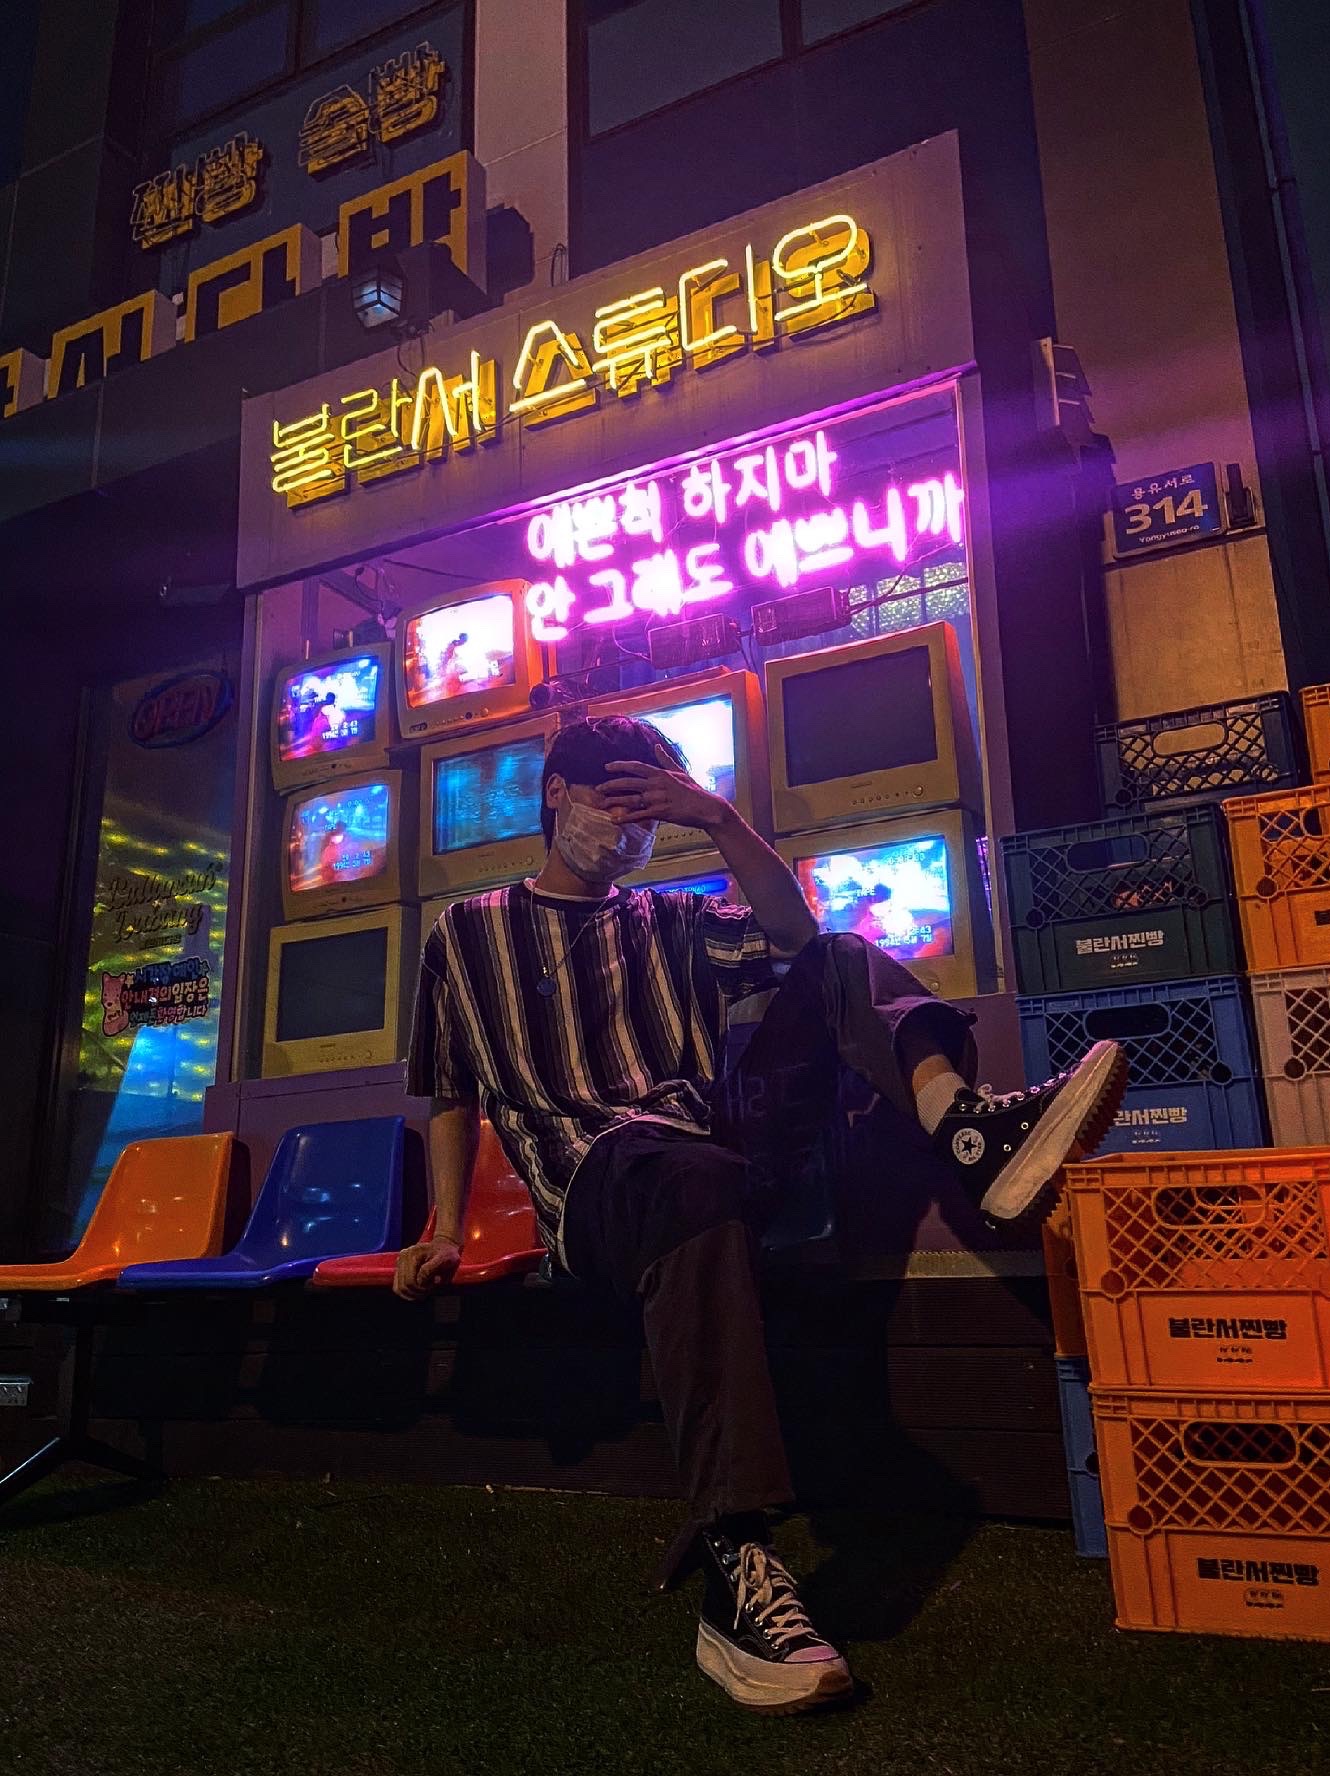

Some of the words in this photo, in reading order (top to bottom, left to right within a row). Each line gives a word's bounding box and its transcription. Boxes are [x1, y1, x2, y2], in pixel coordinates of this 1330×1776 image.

[270, 349, 498, 508] 불란서
[508, 213, 876, 431] 스튜디오
[526, 479, 663, 569] 예쁜척
[681, 430, 839, 524] 하지마
[1131, 474, 1195, 500] 용유서로
[1124, 489, 1209, 535] 314
[524, 573, 577, 642] 안
[582, 542, 735, 618] 그래도
[743, 470, 966, 590] 예쁘니까
[1075, 929, 1165, 956] 불란서찐빵
[1112, 1105, 1188, 1127] 란서찐빵
[1168, 1317, 1288, 1341] 불란서찐빵
[1197, 1556, 1320, 1588] 불란서찐빵
